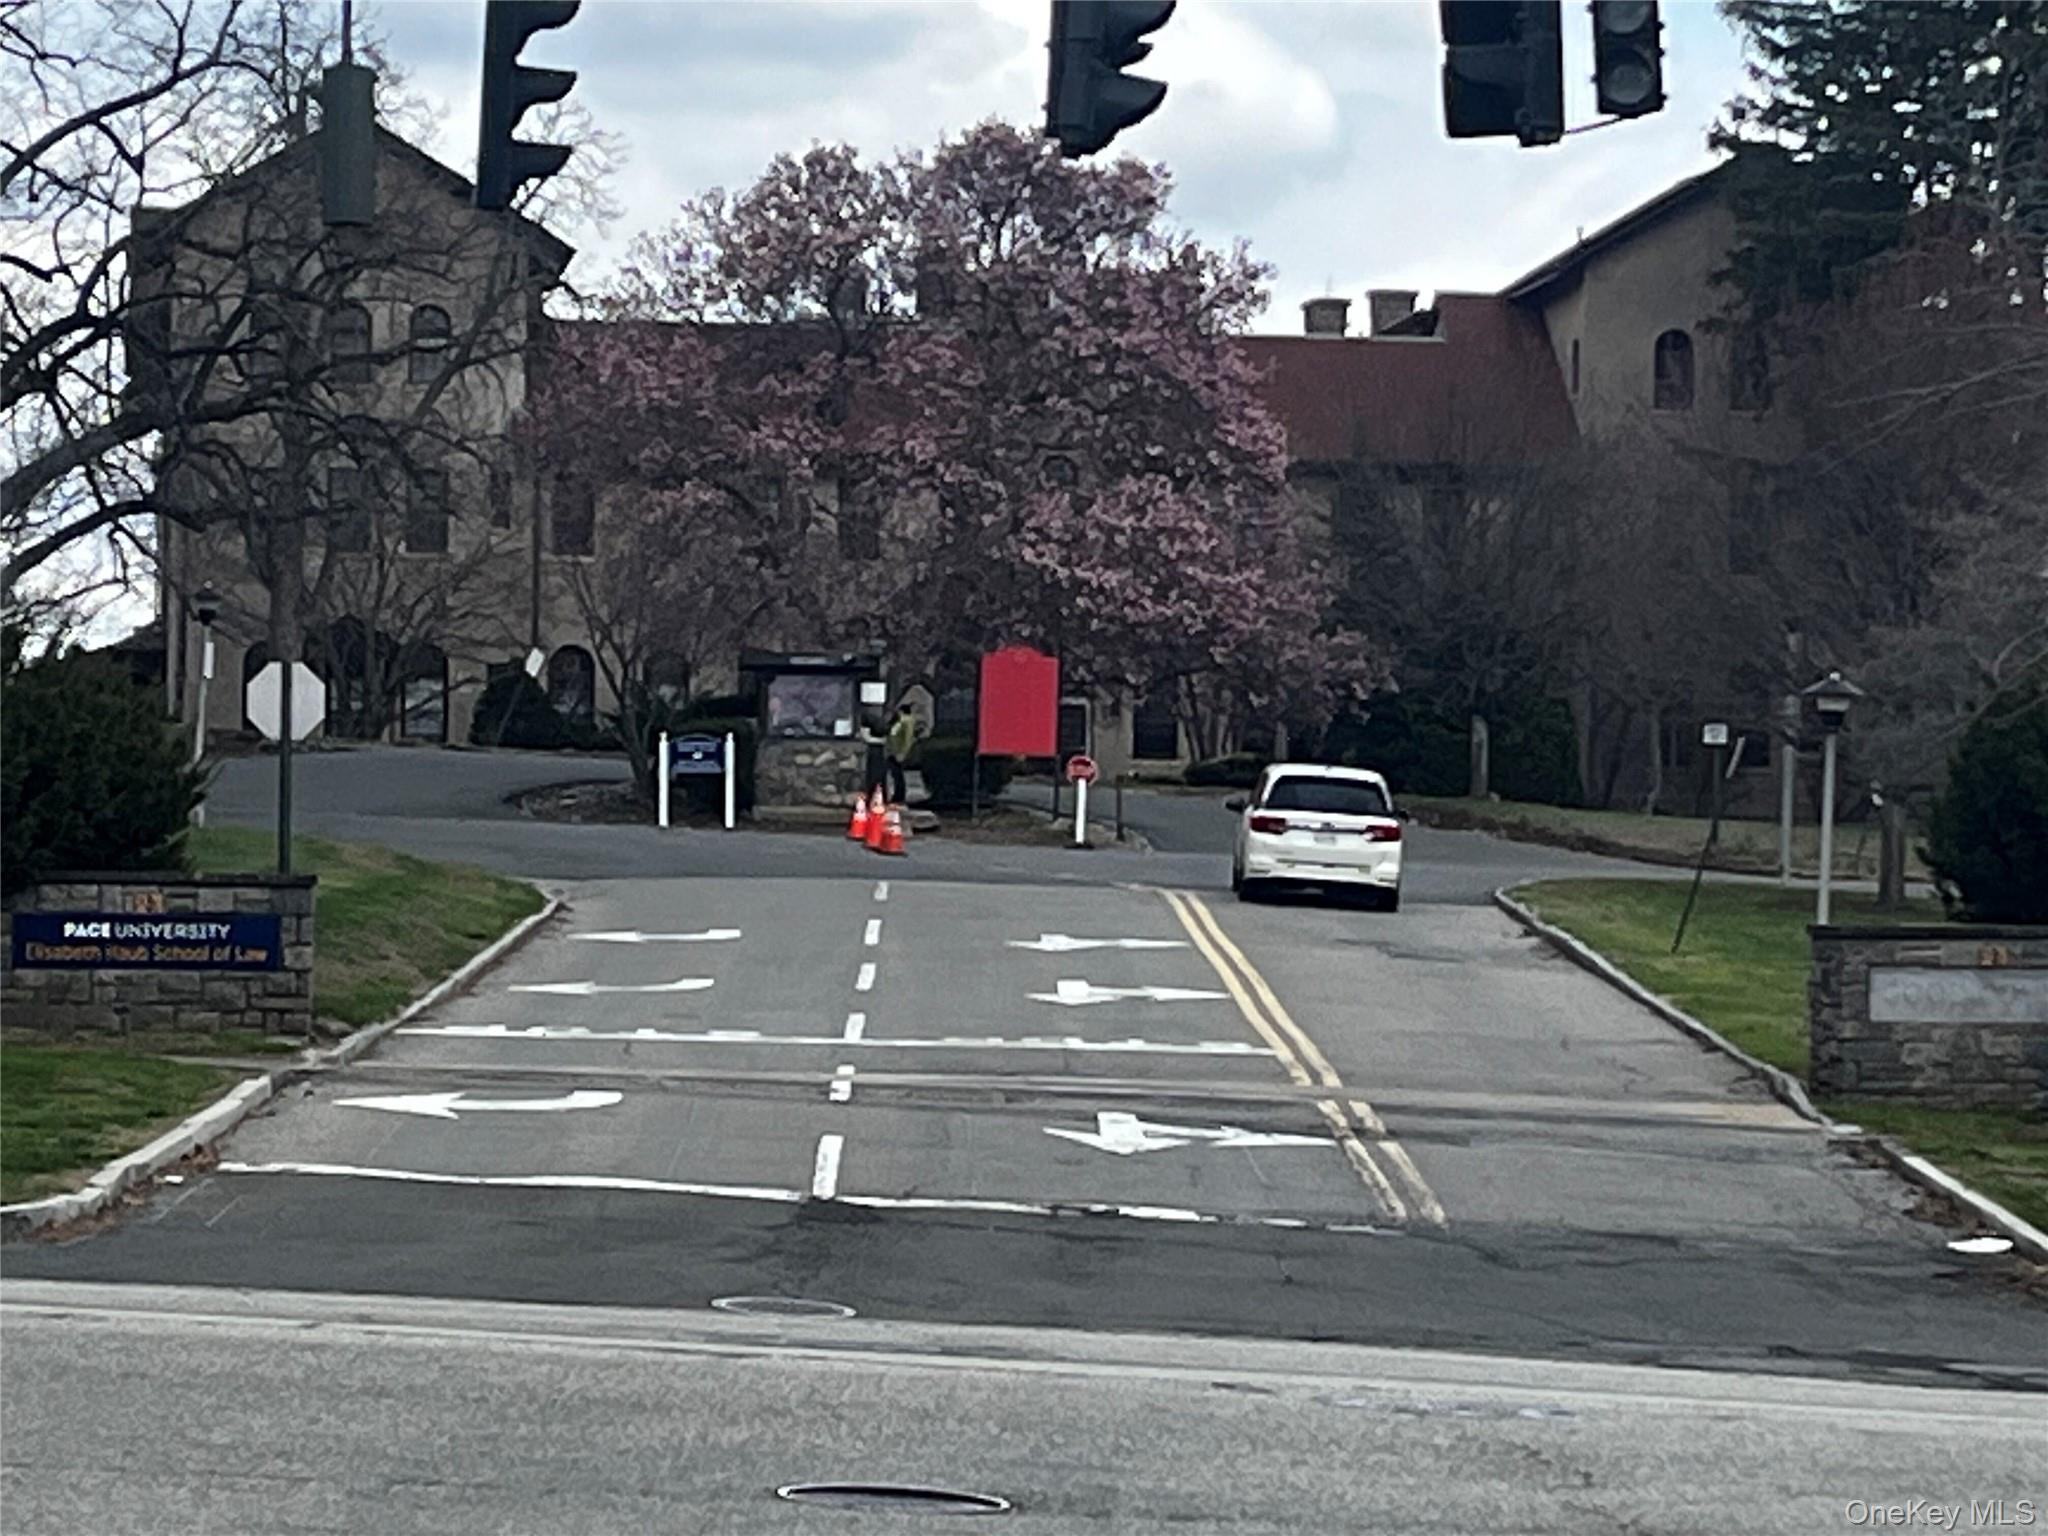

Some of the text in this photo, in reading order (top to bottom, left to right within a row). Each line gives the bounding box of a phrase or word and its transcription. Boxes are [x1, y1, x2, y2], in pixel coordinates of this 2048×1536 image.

[63, 922, 231, 939] PACE UNIVERSITY
[153, 943, 209, 962] School
[213, 944, 230, 962] of
[234, 944, 269, 962] Law
